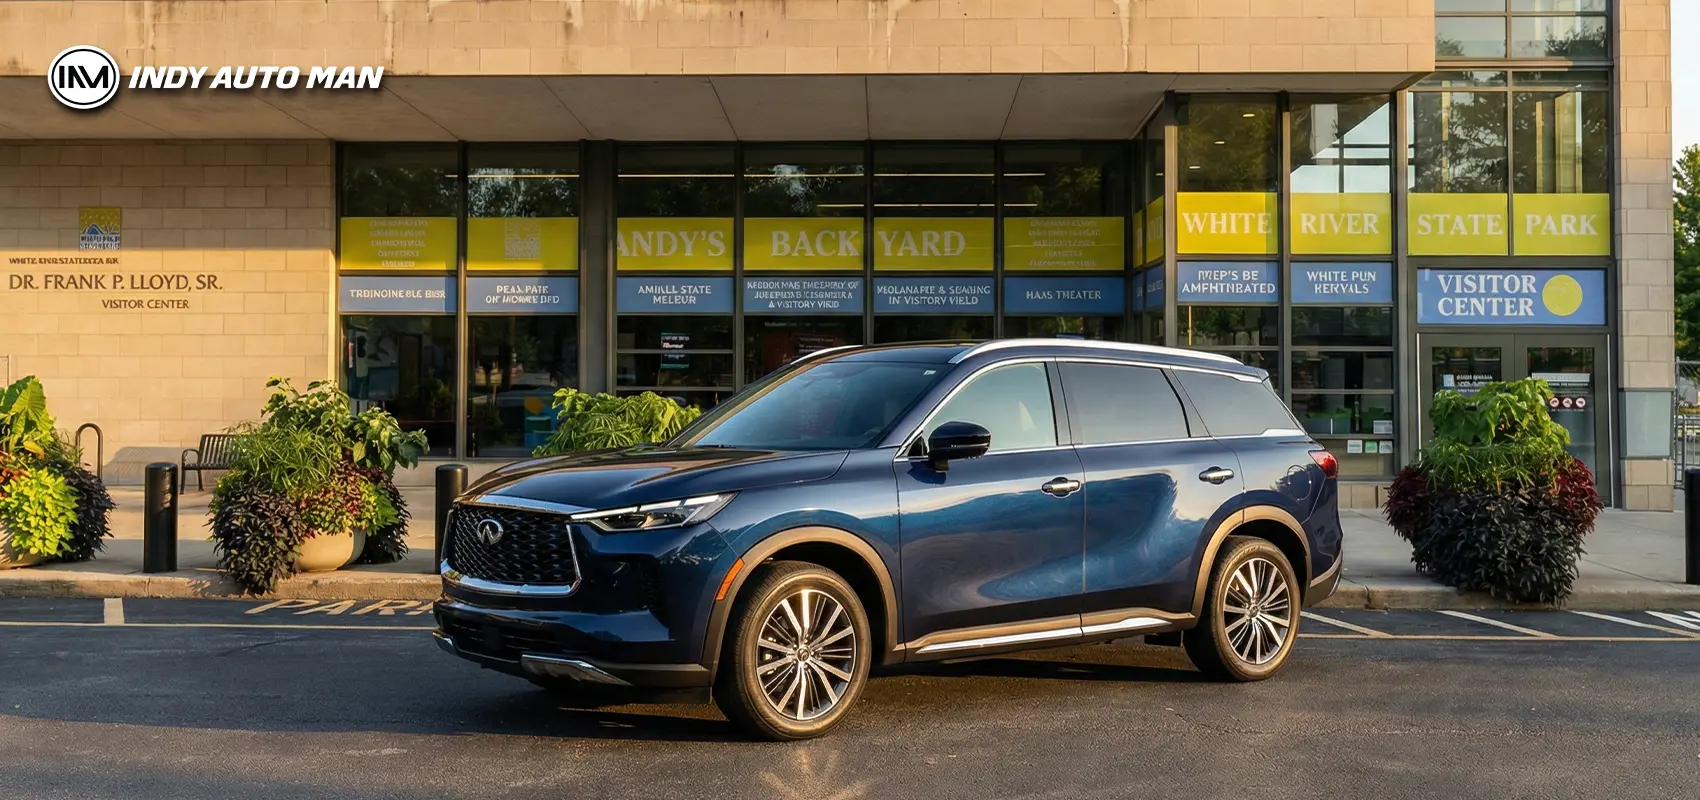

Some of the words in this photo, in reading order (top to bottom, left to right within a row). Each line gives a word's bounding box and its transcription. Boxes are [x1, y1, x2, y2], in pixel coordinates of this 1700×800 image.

[1181, 212, 1273, 235] WHITE
[1300, 212, 1380, 235] RIVER
[1416, 213, 1504, 236] STATE
[1525, 213, 1599, 236] PARK
[617, 230, 726, 257] ANDY'S
[771, 230, 860, 257] BACK
[877, 230, 966, 257] YARD
[9, 274, 39, 290] DR.
[44, 274, 107, 290] FRANK
[112, 274, 125, 290] P.
[130, 274, 192, 293] LLOYD,
[195, 274, 223, 290] SR.
[1306, 271, 1348, 282] WHITE
[1436, 274, 1537, 293] VISITOR
[680, 285, 712, 295] STATE
[938, 285, 948, 294] &
[1057, 290, 1102, 300] THEATER
[102, 299, 145, 309] VISITOR
[147, 299, 190, 309] CENTER
[1437, 297, 1536, 317] CENTER
